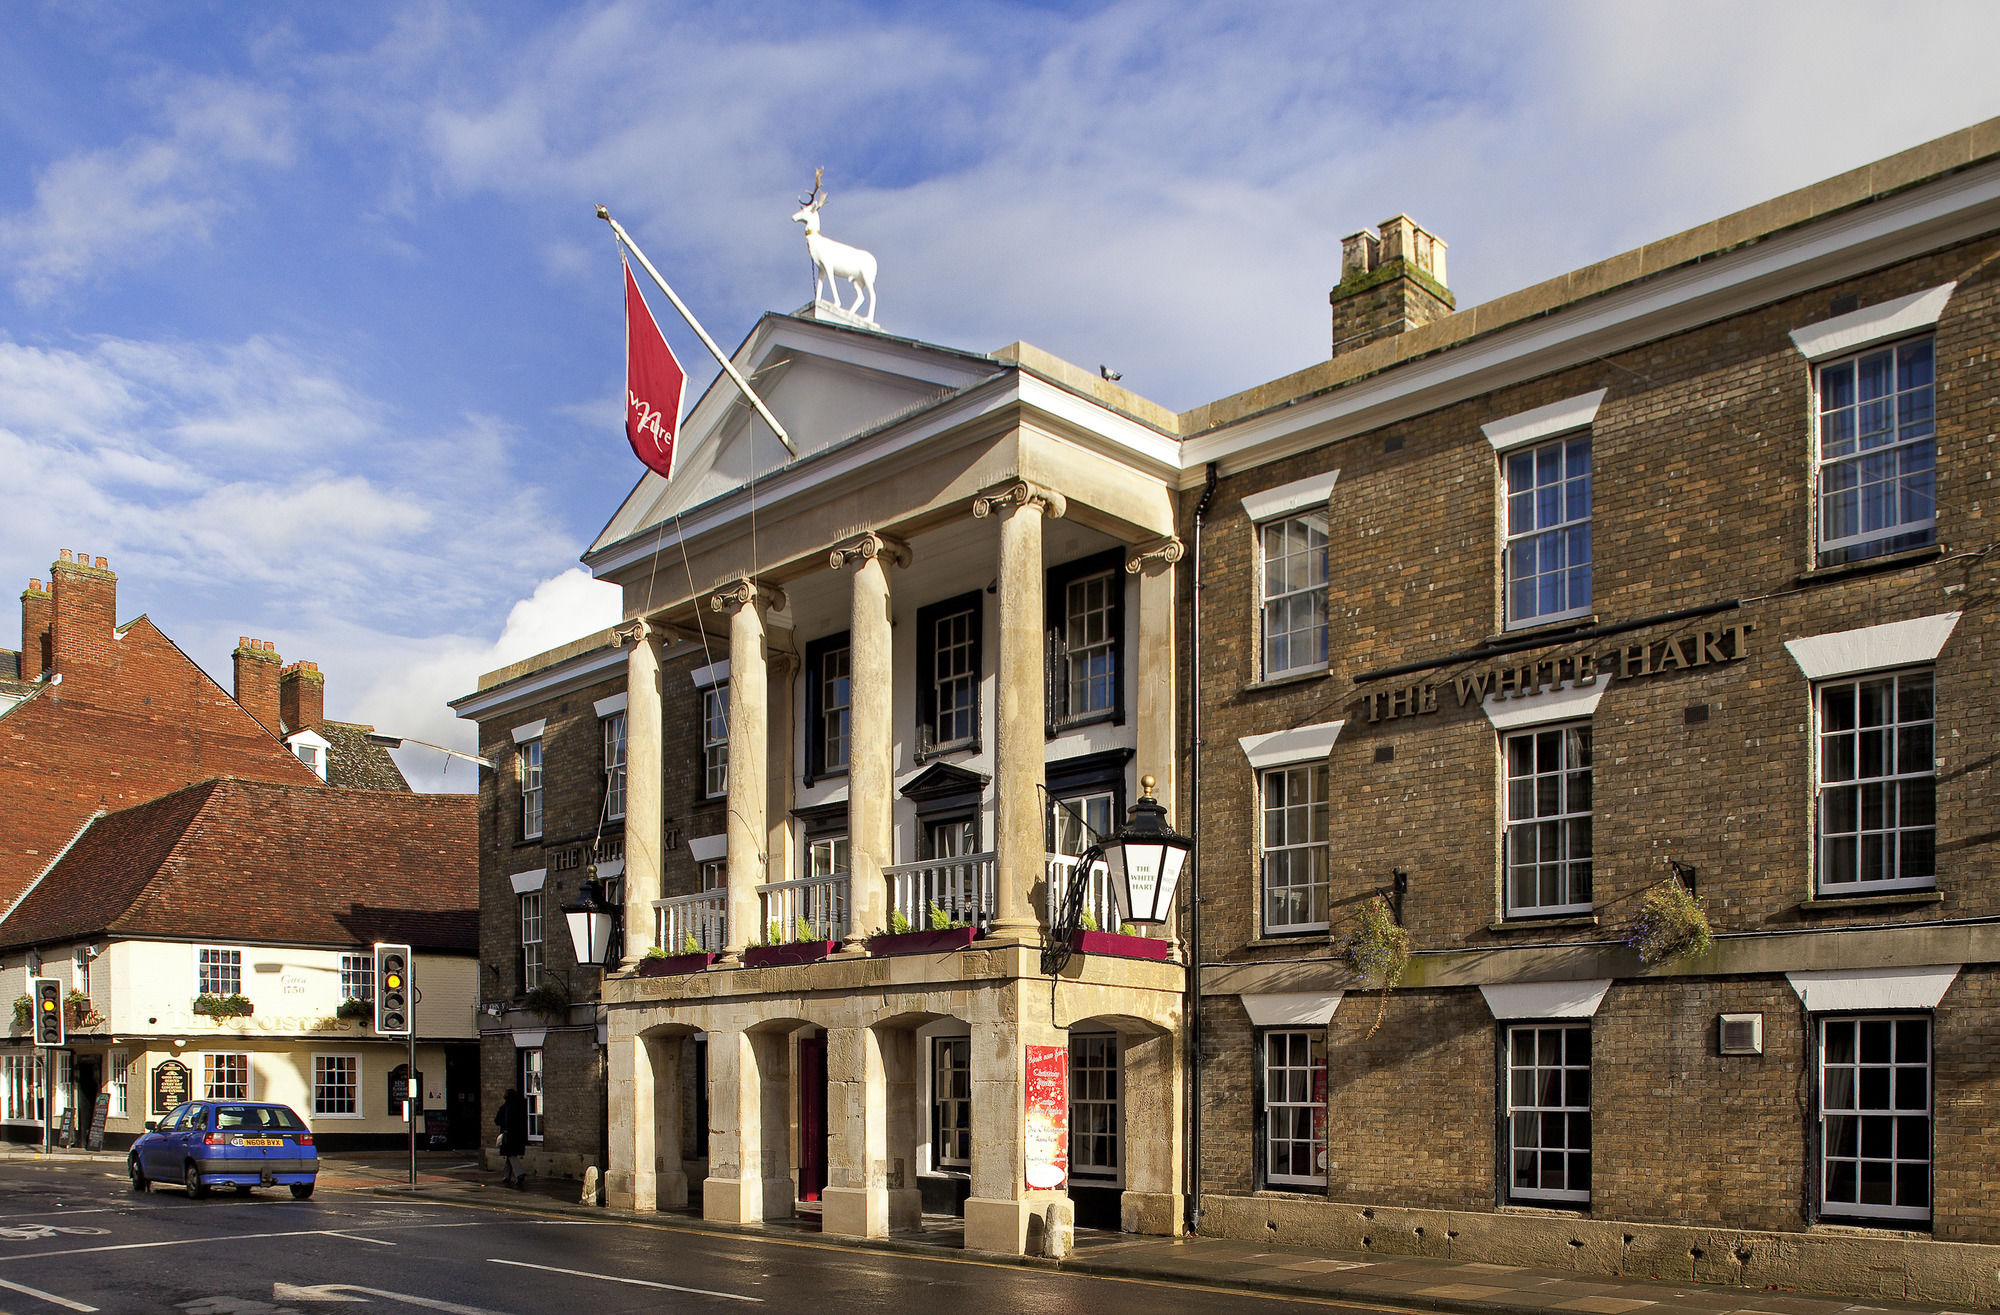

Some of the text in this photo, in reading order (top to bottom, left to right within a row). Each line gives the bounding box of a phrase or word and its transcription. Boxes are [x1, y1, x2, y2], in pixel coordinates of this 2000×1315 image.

[1362, 620, 1757, 723] THE WHITE HART
[552, 848, 578, 871] THE
[226, 1014, 352, 1032] CLOISTERS
